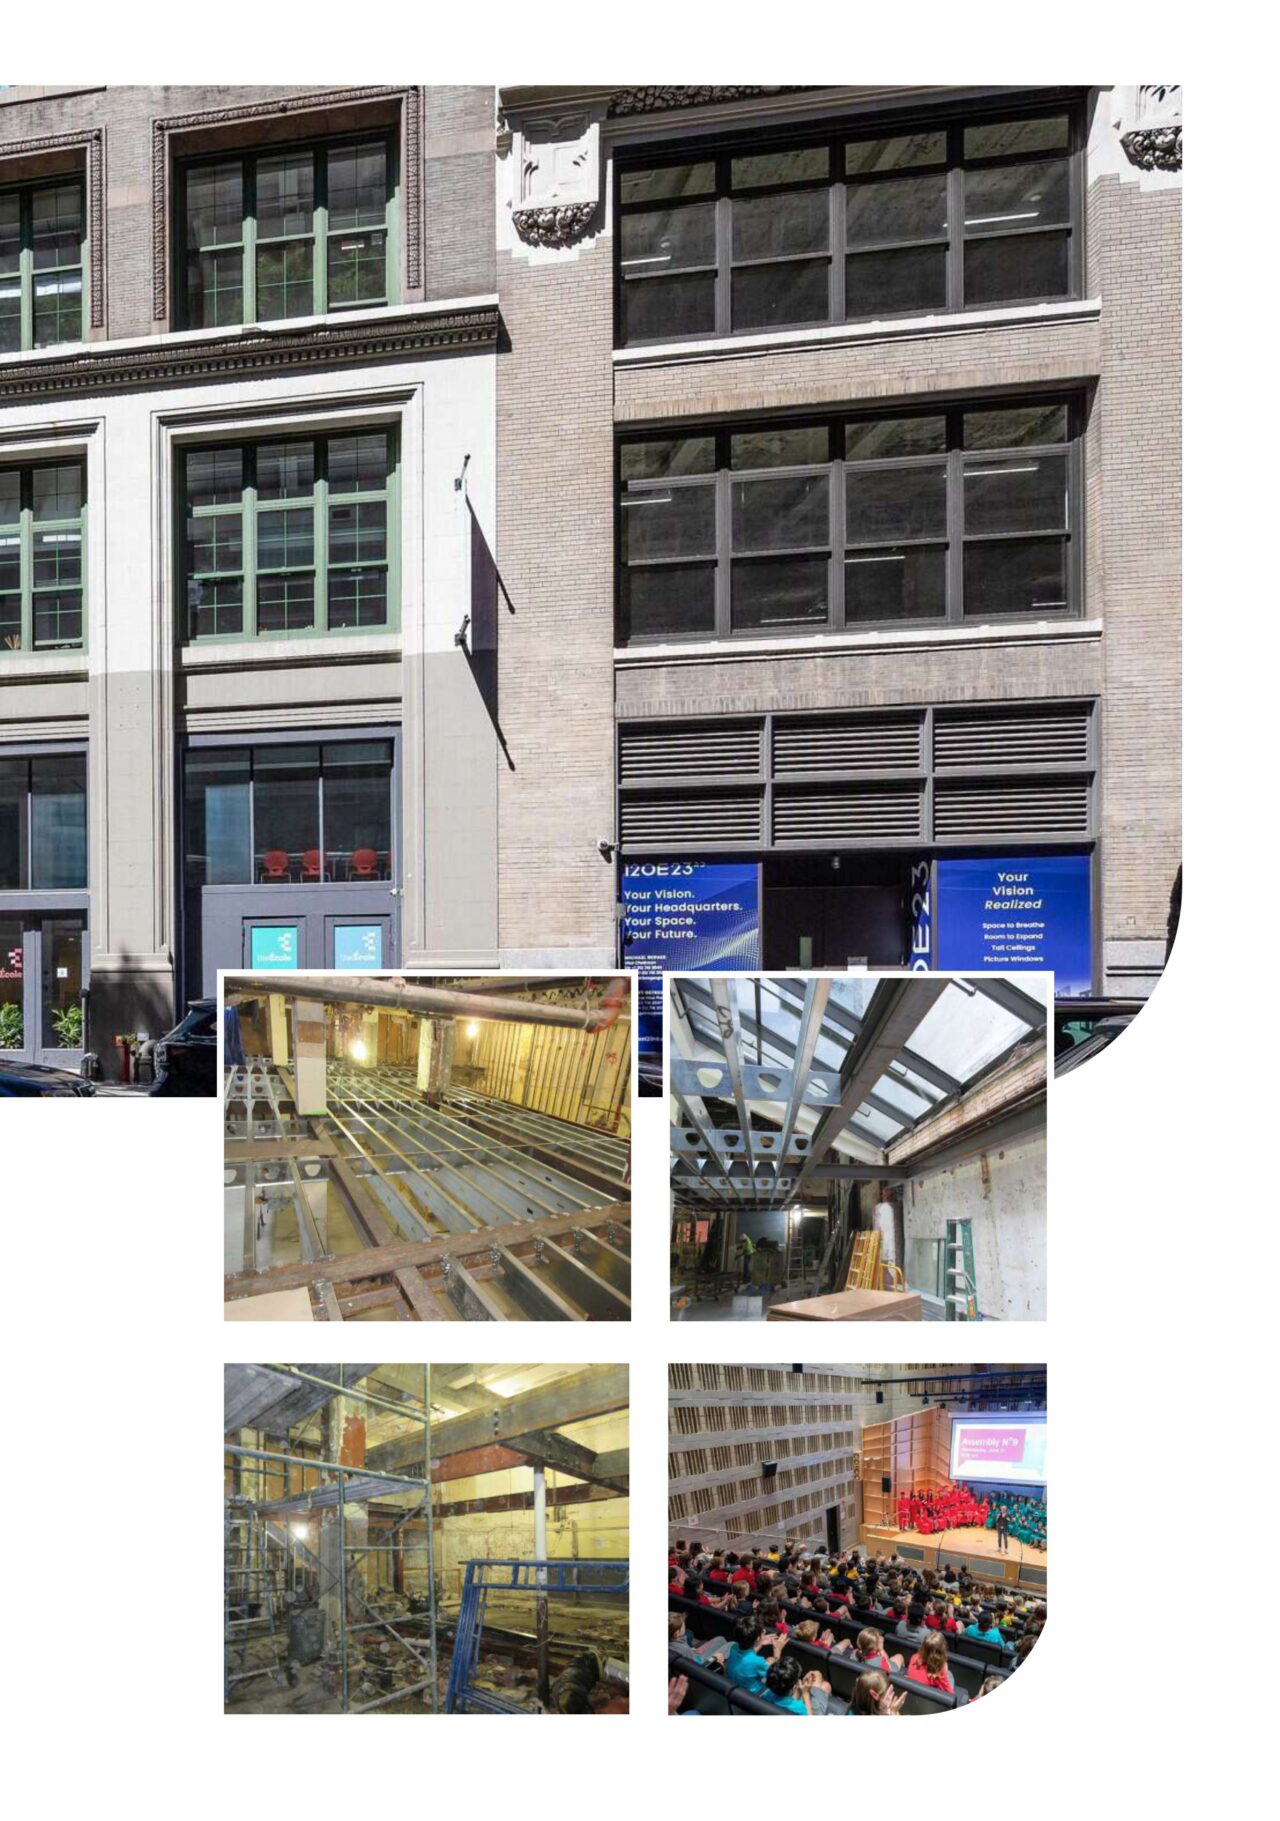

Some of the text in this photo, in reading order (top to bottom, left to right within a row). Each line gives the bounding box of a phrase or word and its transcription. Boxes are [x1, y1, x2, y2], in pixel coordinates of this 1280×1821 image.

[997, 872, 1029, 883] Your
[624, 889, 696, 900] Your Vision.
[992, 886, 1034, 896] Vision
[654, 902, 743, 915] Headquarters.
[984, 899, 1042, 910] Realized
[624, 917, 697, 928] Your Space.
[982, 922, 1006, 930] Space
[655, 930, 698, 940] Future.
[1016, 933, 1043, 941] Expand
[1006, 944, 1035, 952] Ceilings
[962, 1438, 999, 1448] Assembly
